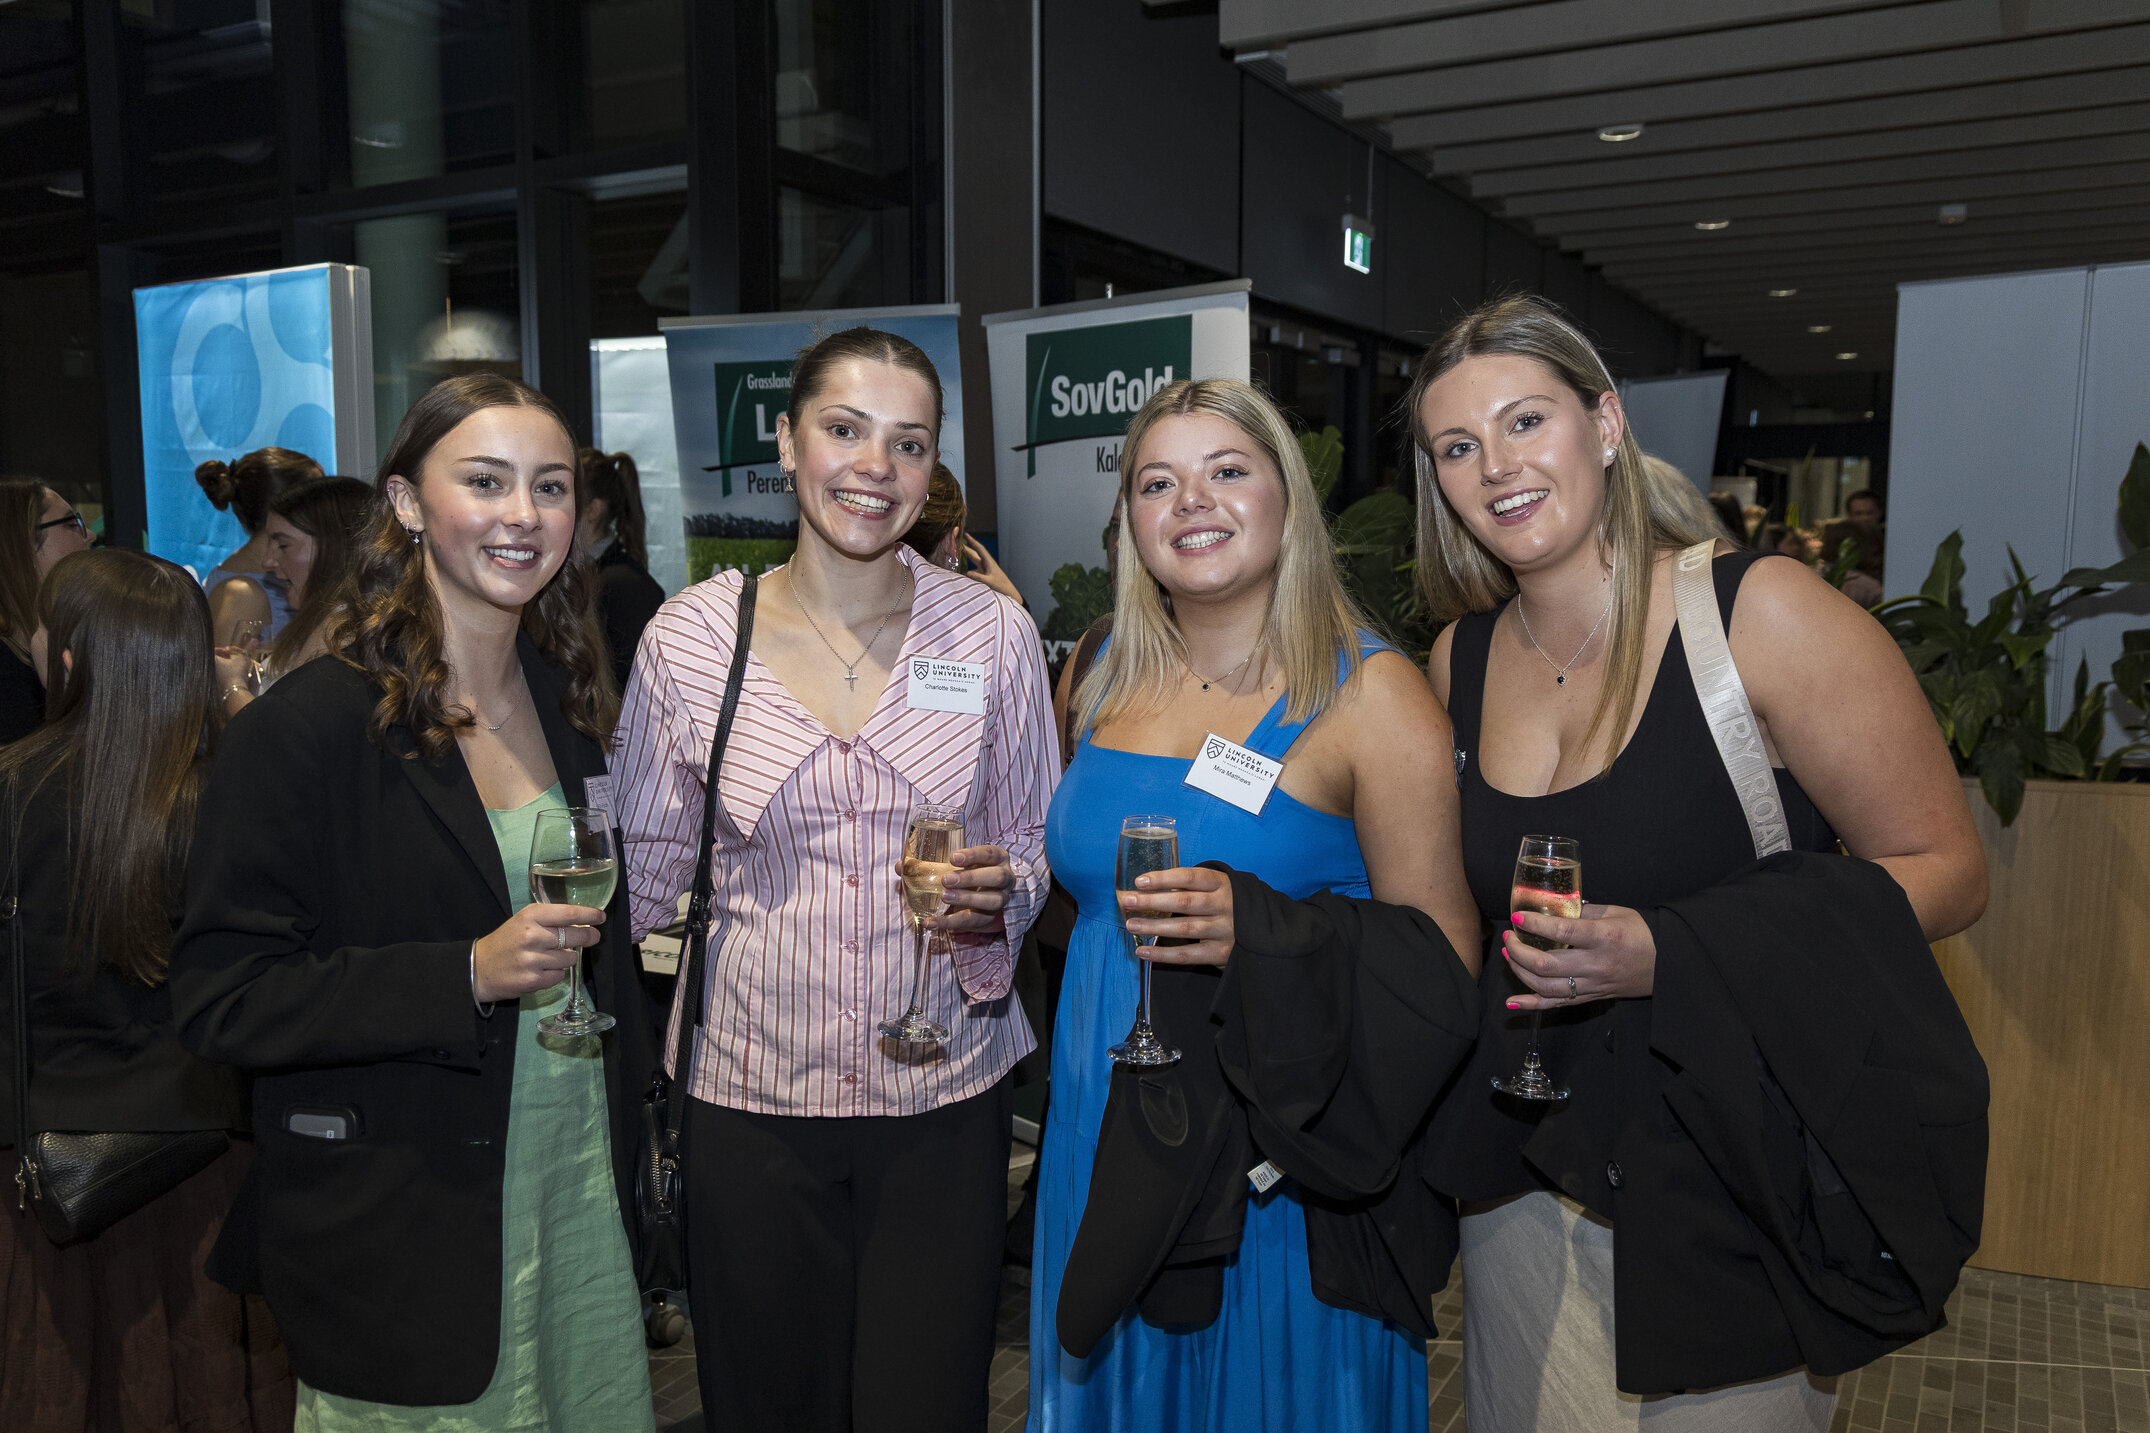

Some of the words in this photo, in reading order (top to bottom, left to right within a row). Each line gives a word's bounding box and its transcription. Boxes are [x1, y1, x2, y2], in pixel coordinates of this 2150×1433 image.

[1050, 365, 1174, 419] SovGold
[1096, 443, 1122, 473] Kal
[932, 664, 966, 672] LINCOLN
[932, 670, 981, 679] UNIVERSITY
[925, 683, 949, 691] Charlotte
[949, 685, 968, 693] Stokes
[1225, 753, 1274, 778] UNIVERSITY
[1227, 748, 1262, 766] LINCOLN
[1213, 765, 1225, 774] Mira
[1226, 770, 1251, 786] Matthews
